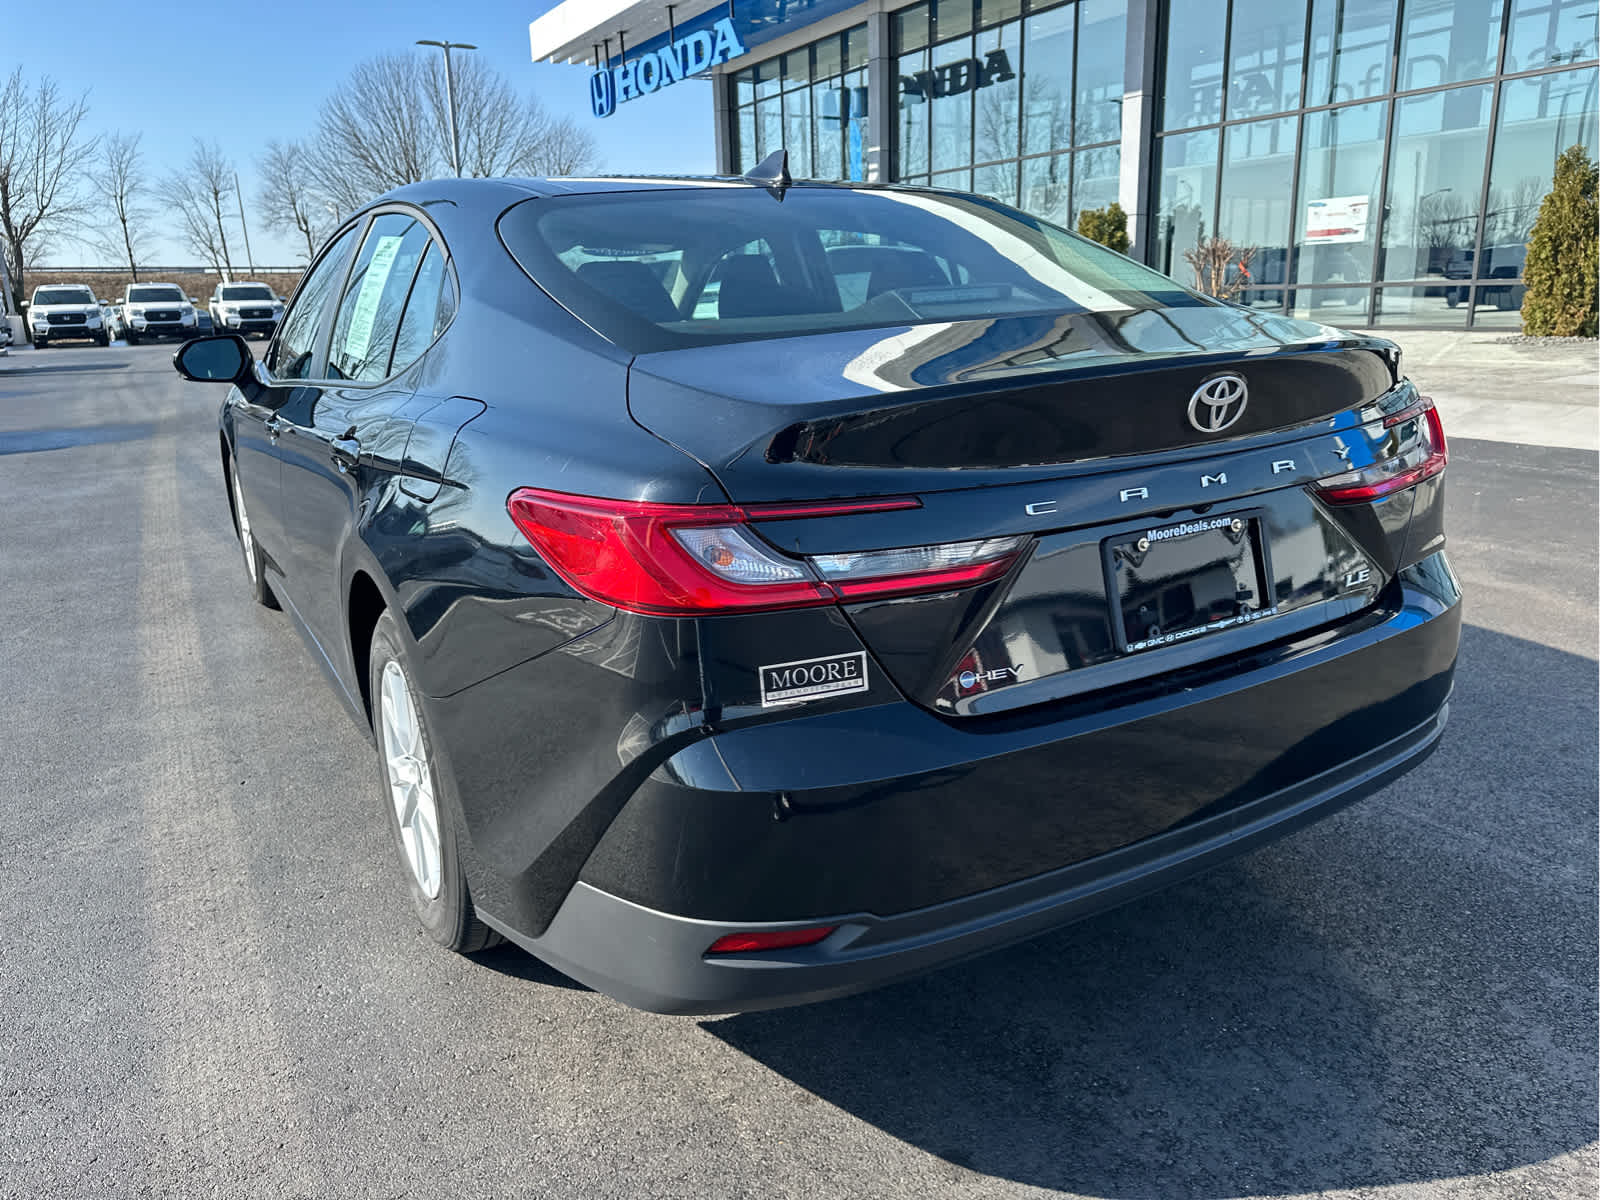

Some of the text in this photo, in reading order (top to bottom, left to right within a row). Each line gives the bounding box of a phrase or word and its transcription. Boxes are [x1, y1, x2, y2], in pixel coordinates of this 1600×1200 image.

[614, 17, 744, 104] HONDA
[1147, 516, 1232, 543] MooreDeals.com
[1345, 568, 1370, 588] LE
[770, 659, 858, 689] MOORE
